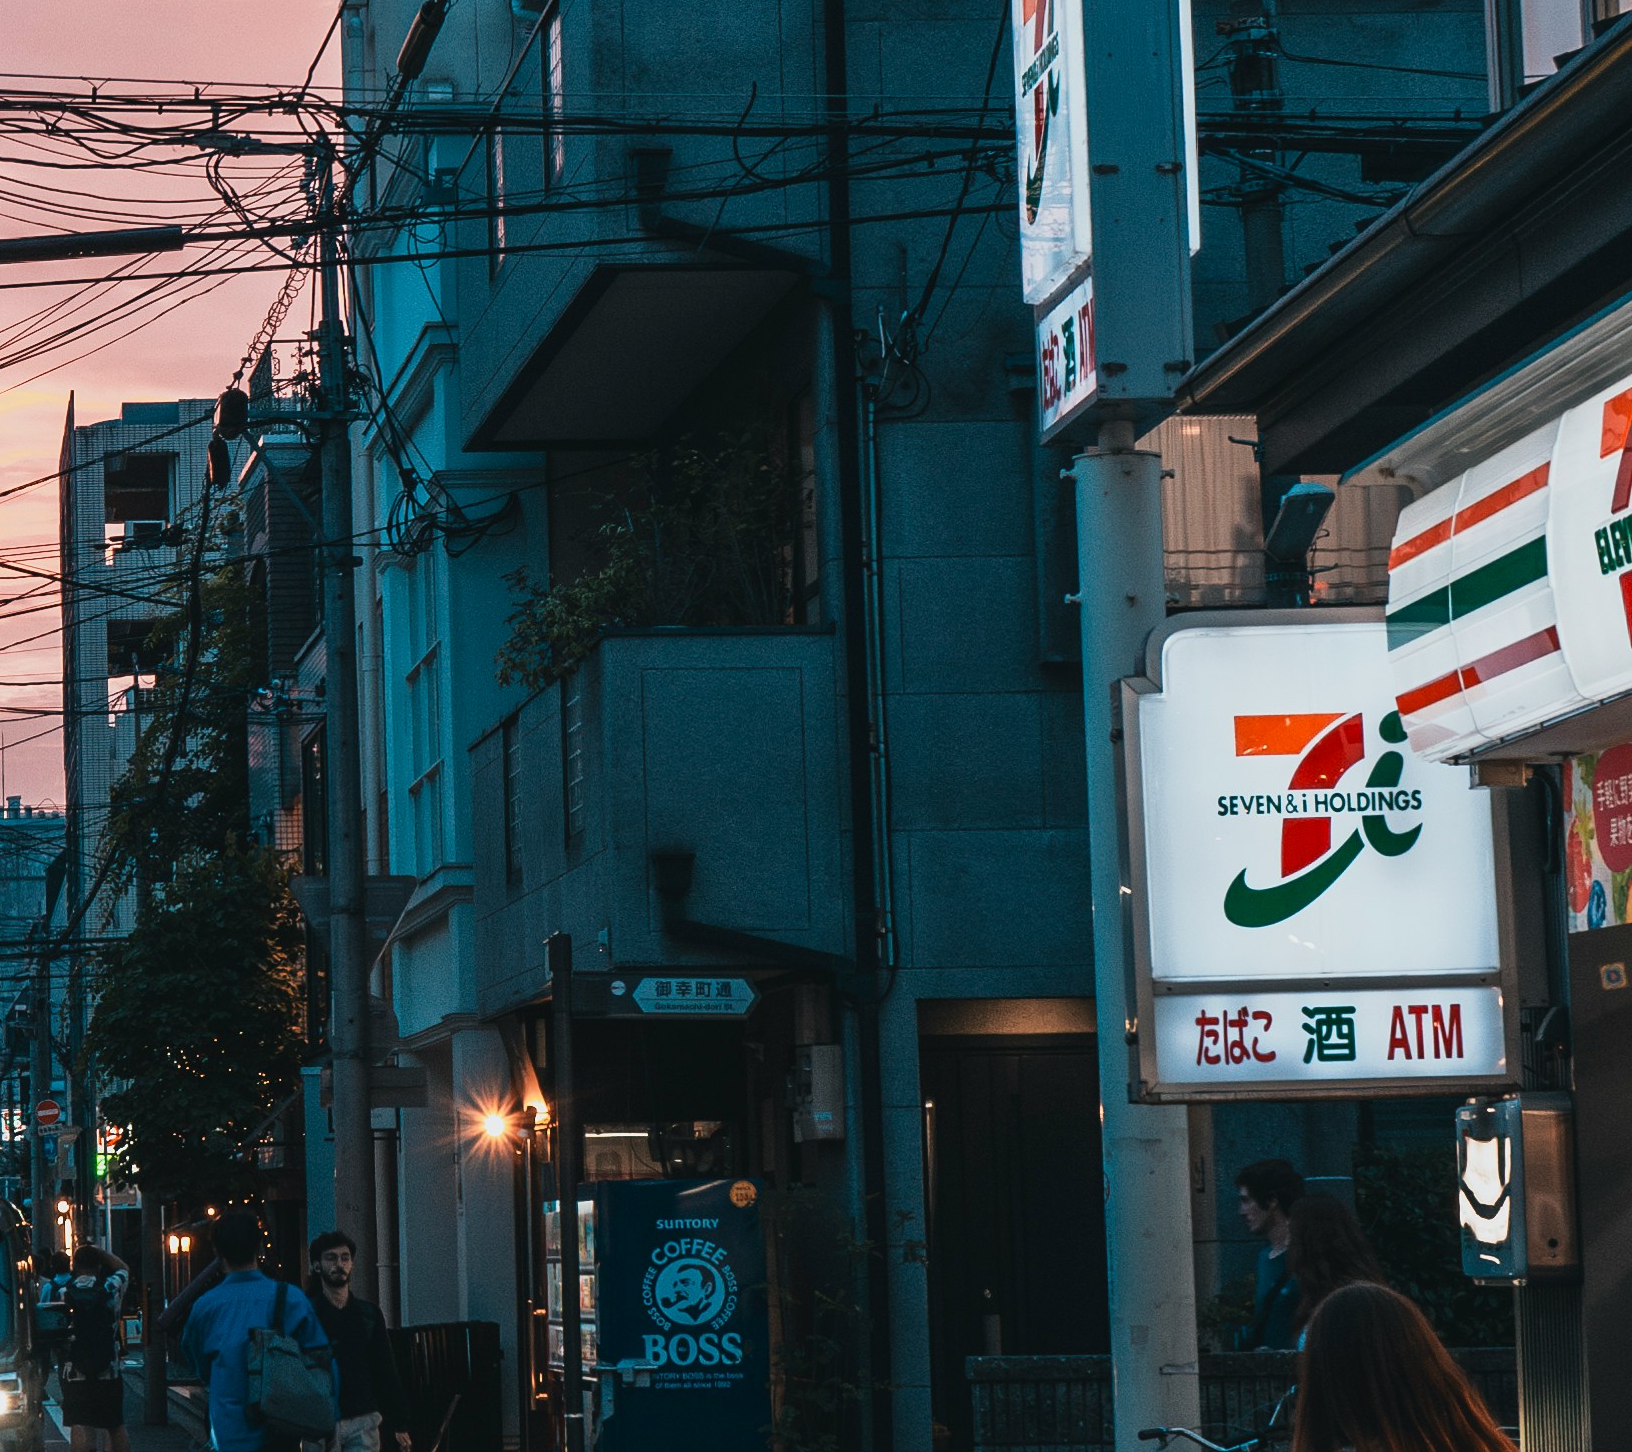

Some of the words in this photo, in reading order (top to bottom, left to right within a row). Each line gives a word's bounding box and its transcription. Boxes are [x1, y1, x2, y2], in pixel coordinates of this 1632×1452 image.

[1313, 788, 1423, 815] HOLDINGS
[654, 980, 733, 998] 御幸町通
[1194, 1007, 1278, 1067] たばこ
[1301, 1005, 1357, 1064] 酒
[1387, 1004, 1465, 1062] ATM
[655, 1217, 719, 1230] SUNTORY
[651, 1237, 728, 1265] COFFEE
[641, 1265, 658, 1306] COFFEE
[721, 1264, 738, 1293] BOSS
[647, 1306, 672, 1332] BOSS
[711, 1294, 738, 1331] COFFEE
[641, 1332, 743, 1367] BOSS
